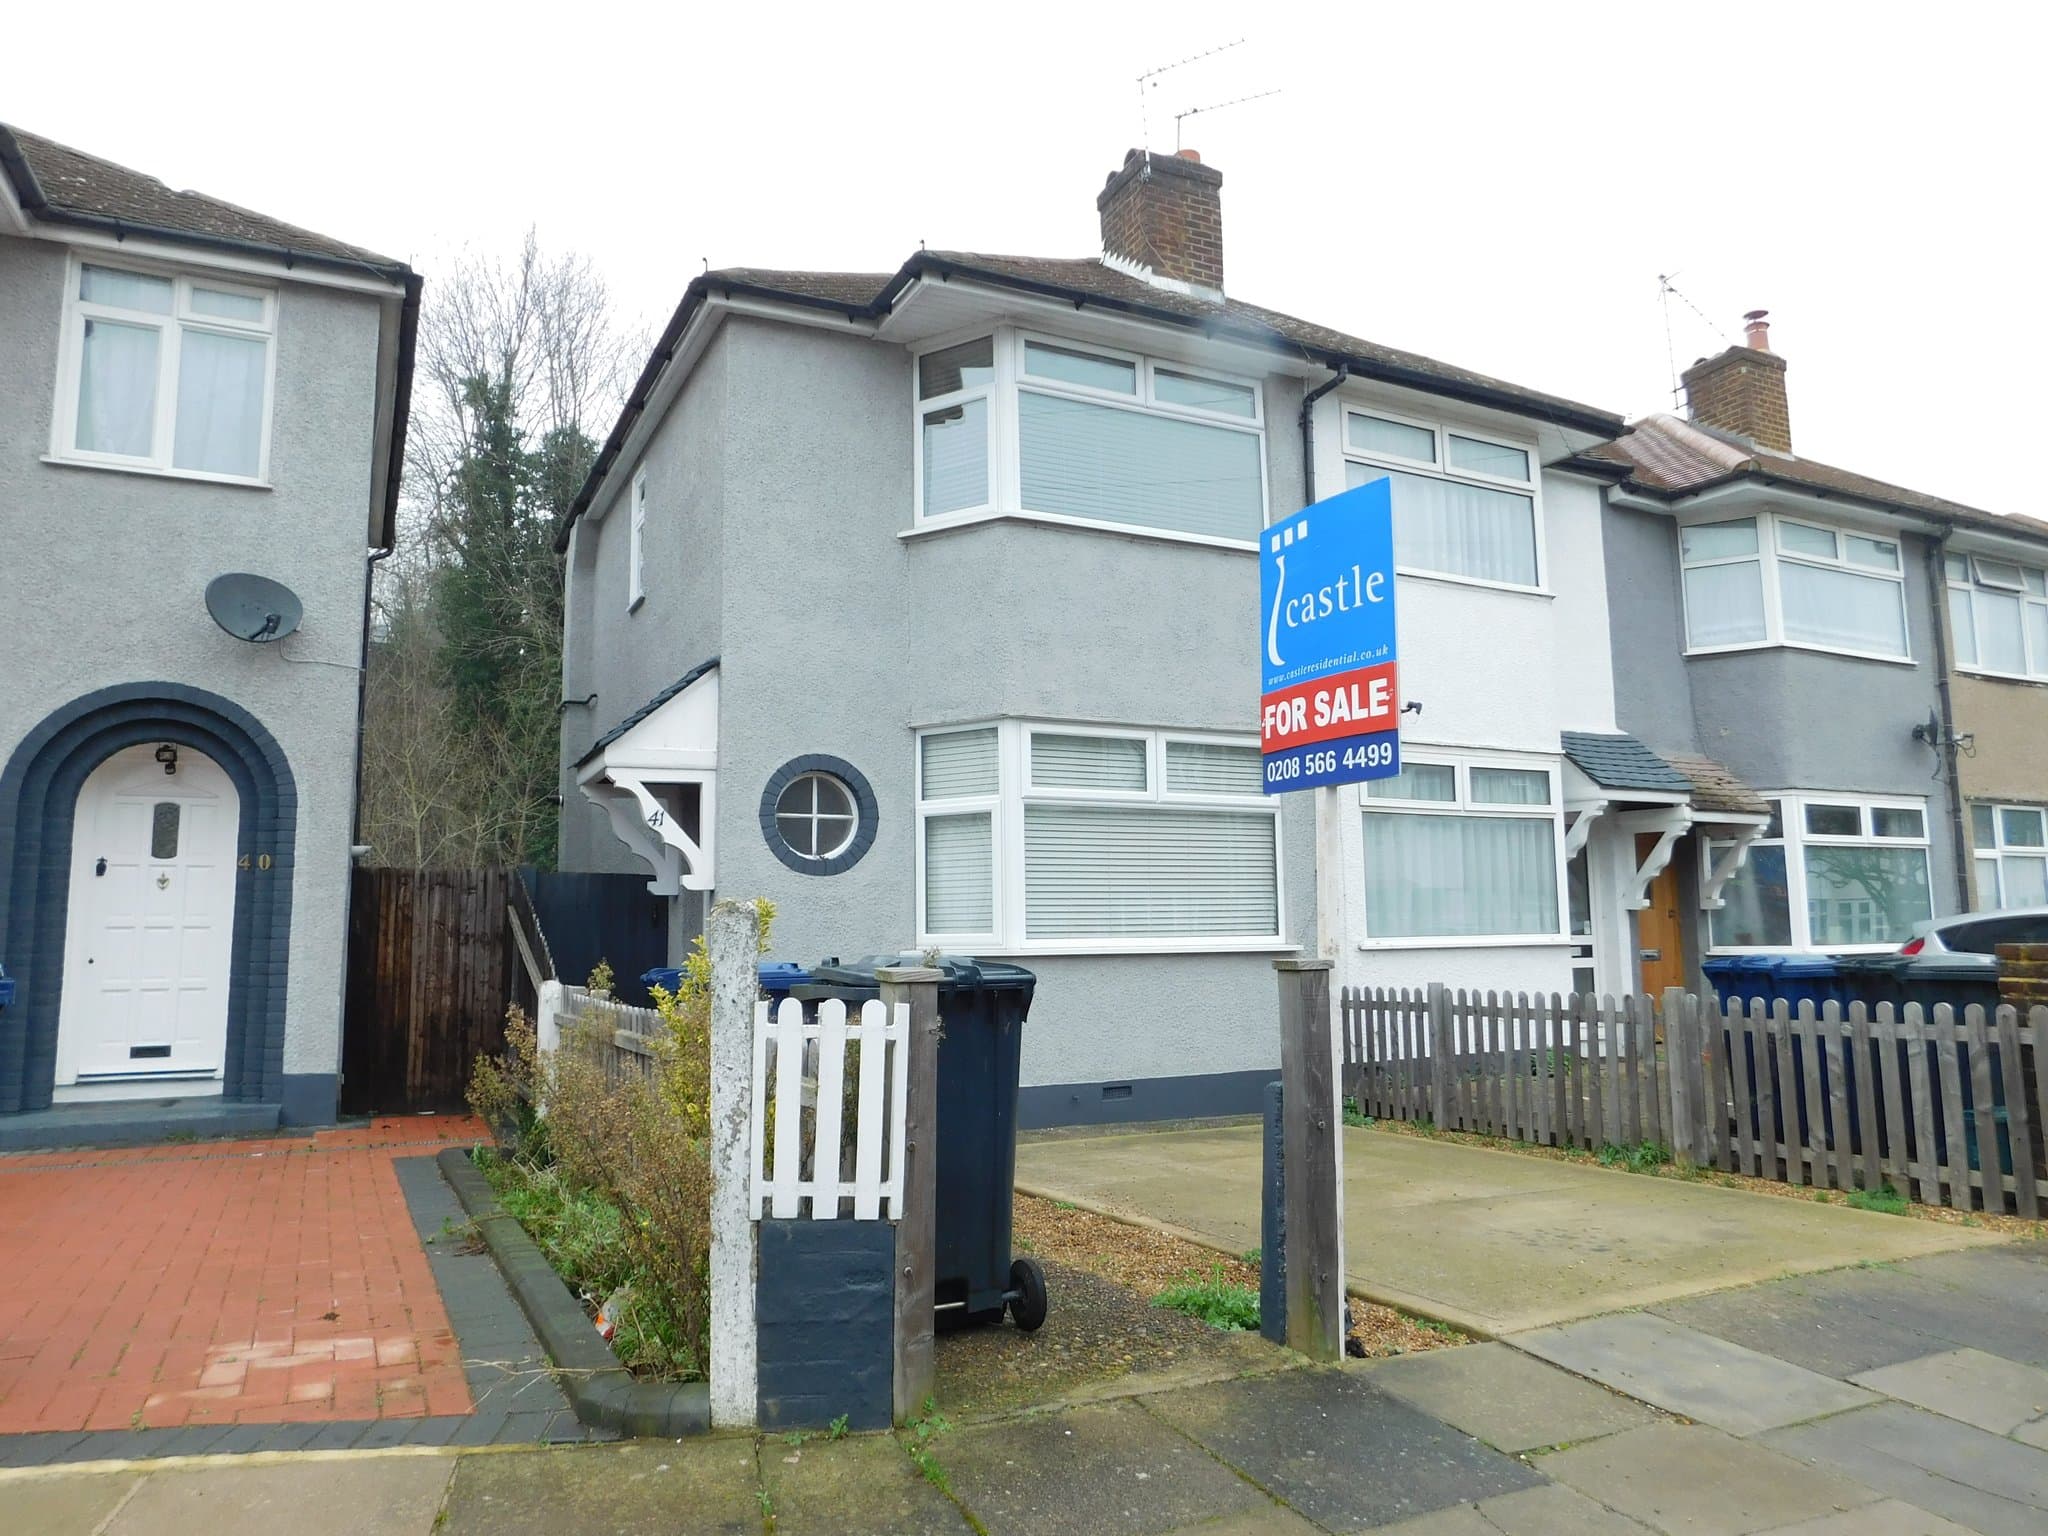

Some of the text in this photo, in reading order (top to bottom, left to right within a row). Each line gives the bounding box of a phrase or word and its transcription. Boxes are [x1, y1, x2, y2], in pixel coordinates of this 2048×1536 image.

[1286, 564, 1384, 627] castle
[1268, 644, 1389, 685] www.castleresidential.co.uk
[1264, 677, 1389, 740] FOR SALE
[1267, 742, 1392, 782] 0208 566 4499
[647, 809, 665, 827] 41
